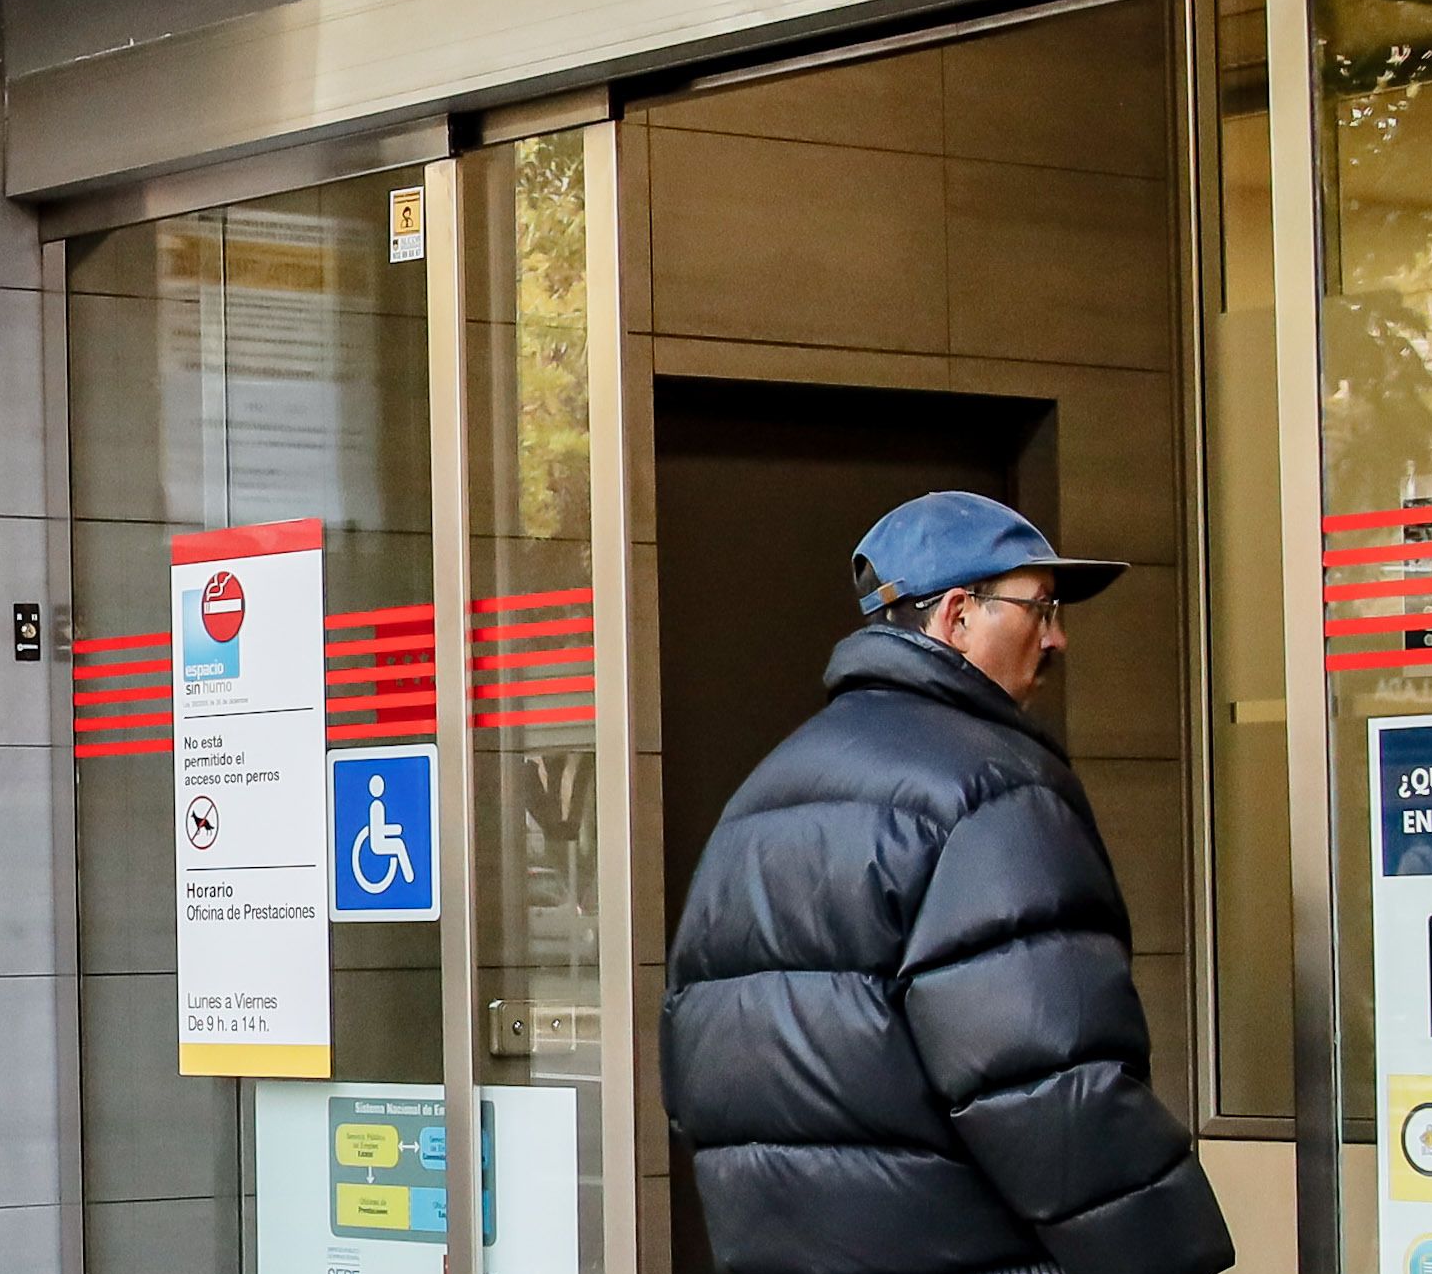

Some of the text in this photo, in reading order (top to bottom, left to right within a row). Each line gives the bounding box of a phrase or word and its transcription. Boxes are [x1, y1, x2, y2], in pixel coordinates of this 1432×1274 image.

[185, 662, 224, 680] espacio
[186, 680, 232, 695] sin humo
[183, 736, 223, 750] No está
[184, 752, 245, 770] permitido el
[184, 770, 280, 787] acceso con perros
[1403, 809, 1432, 834] EN
[186, 881, 233, 899] Horario
[186, 904, 316, 922] Oficina de Prestaciones
[187, 993, 278, 1010] Lunes a Viernes
[187, 1016, 270, 1032] De 9 h. a 14 h.
